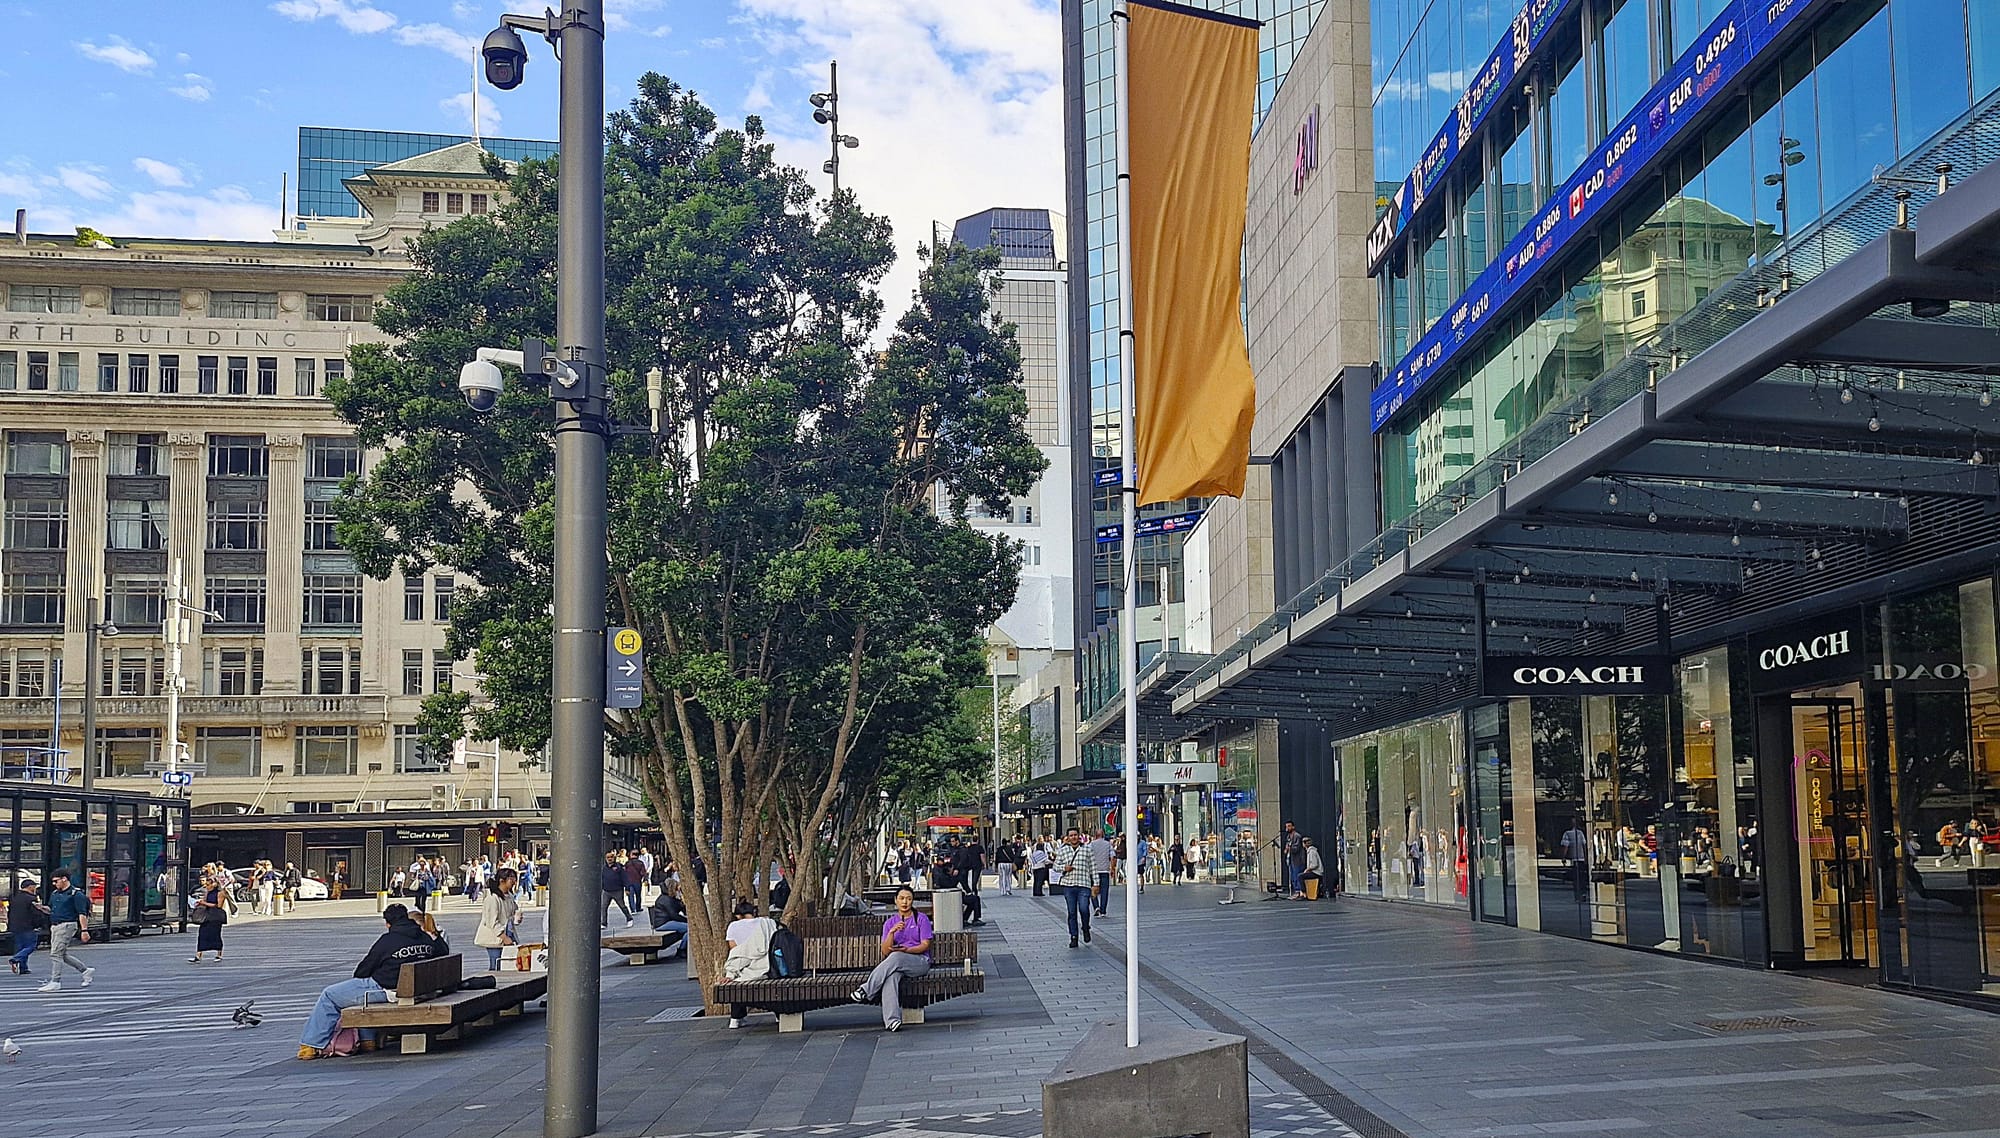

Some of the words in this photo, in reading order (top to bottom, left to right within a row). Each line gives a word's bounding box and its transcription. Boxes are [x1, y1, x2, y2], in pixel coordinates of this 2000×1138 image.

[1513, 16, 1530, 60] 50
[1513, 43, 1531, 75] INDEX
[1669, 77, 1692, 114] EUR
[1695, 21, 1736, 74] 0.4926
[1471, 56, 1500, 107] 7674.39
[1458, 100, 1471, 140] 20
[1424, 132, 1448, 174] 1921.96
[1585, 169, 1604, 199] CAD
[1606, 125, 1637, 167] 0.8052
[1367, 208, 1394, 268] NZX
[1518, 241, 1535, 270] AUD
[1535, 205, 1561, 242] 0.8806
[1471, 293, 1488, 322] 6610
[114, 328, 297, 347] BUILDING
[1426, 341, 1441, 367] 6730
[1759, 630, 1850, 670] COACH
[1513, 666, 1644, 684] COACH
